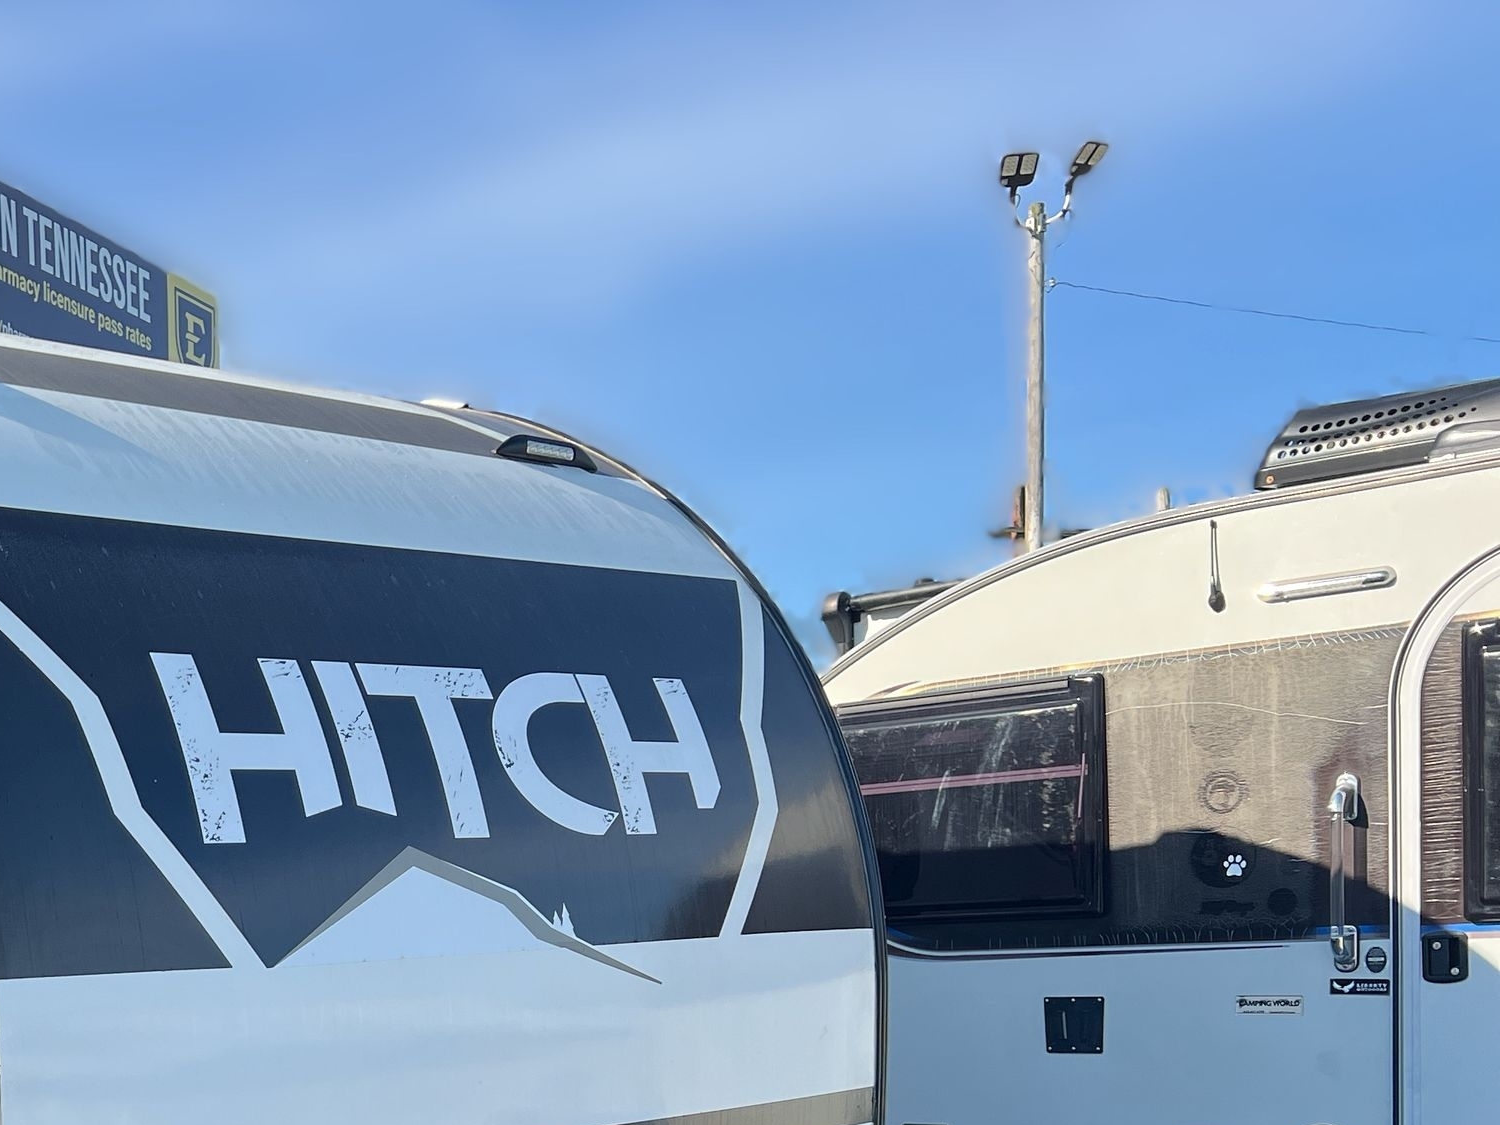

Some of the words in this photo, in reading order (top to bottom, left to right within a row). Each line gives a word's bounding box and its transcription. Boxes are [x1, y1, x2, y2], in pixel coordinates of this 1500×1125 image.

[22, 206, 151, 324] TENNESSEE
[43, 280, 96, 324] licensure
[98, 312, 124, 337] pass
[125, 325, 152, 351] rates
[148, 651, 722, 844] HITCH
